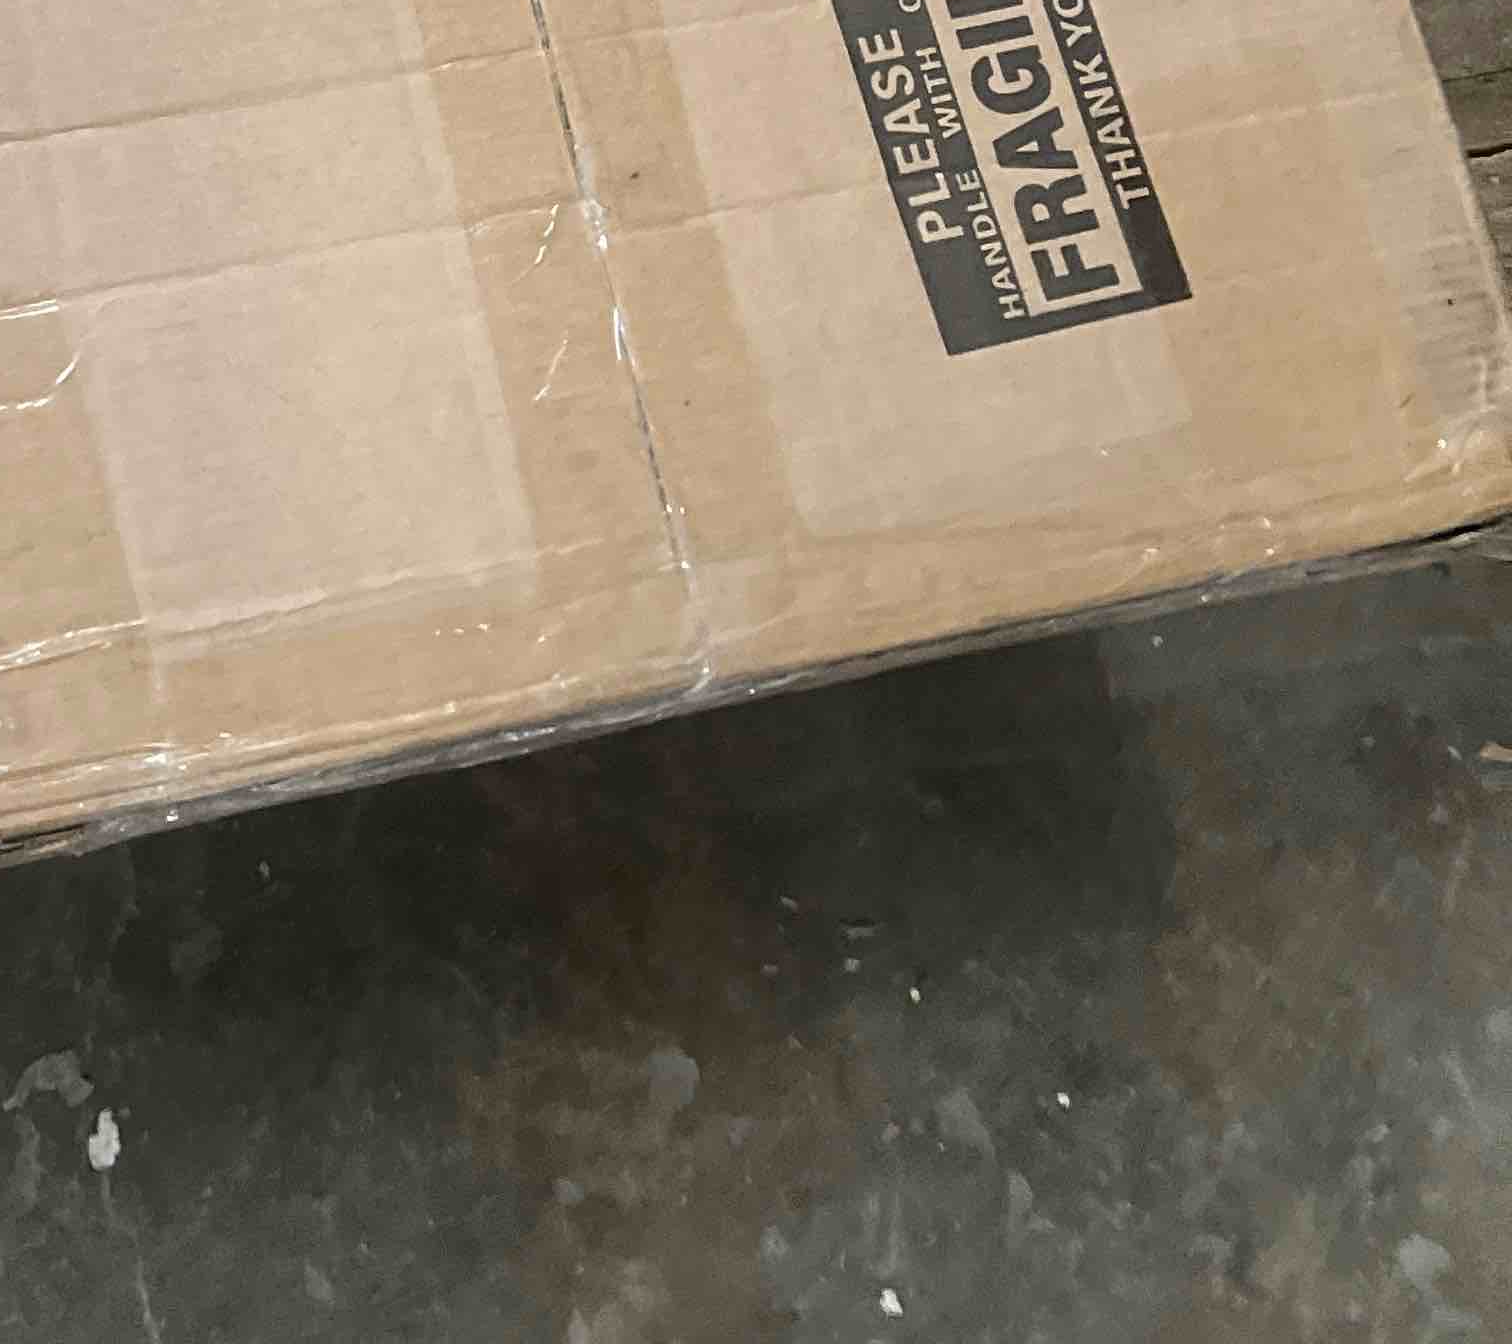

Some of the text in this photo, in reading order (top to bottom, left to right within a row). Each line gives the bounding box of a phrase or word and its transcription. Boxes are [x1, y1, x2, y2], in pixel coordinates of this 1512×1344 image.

[857, 28, 964, 244] PLEASE
[915, 46, 965, 141] WITH
[1073, 53, 1151, 211] THANK
[958, 167, 1026, 321] HANDLE
